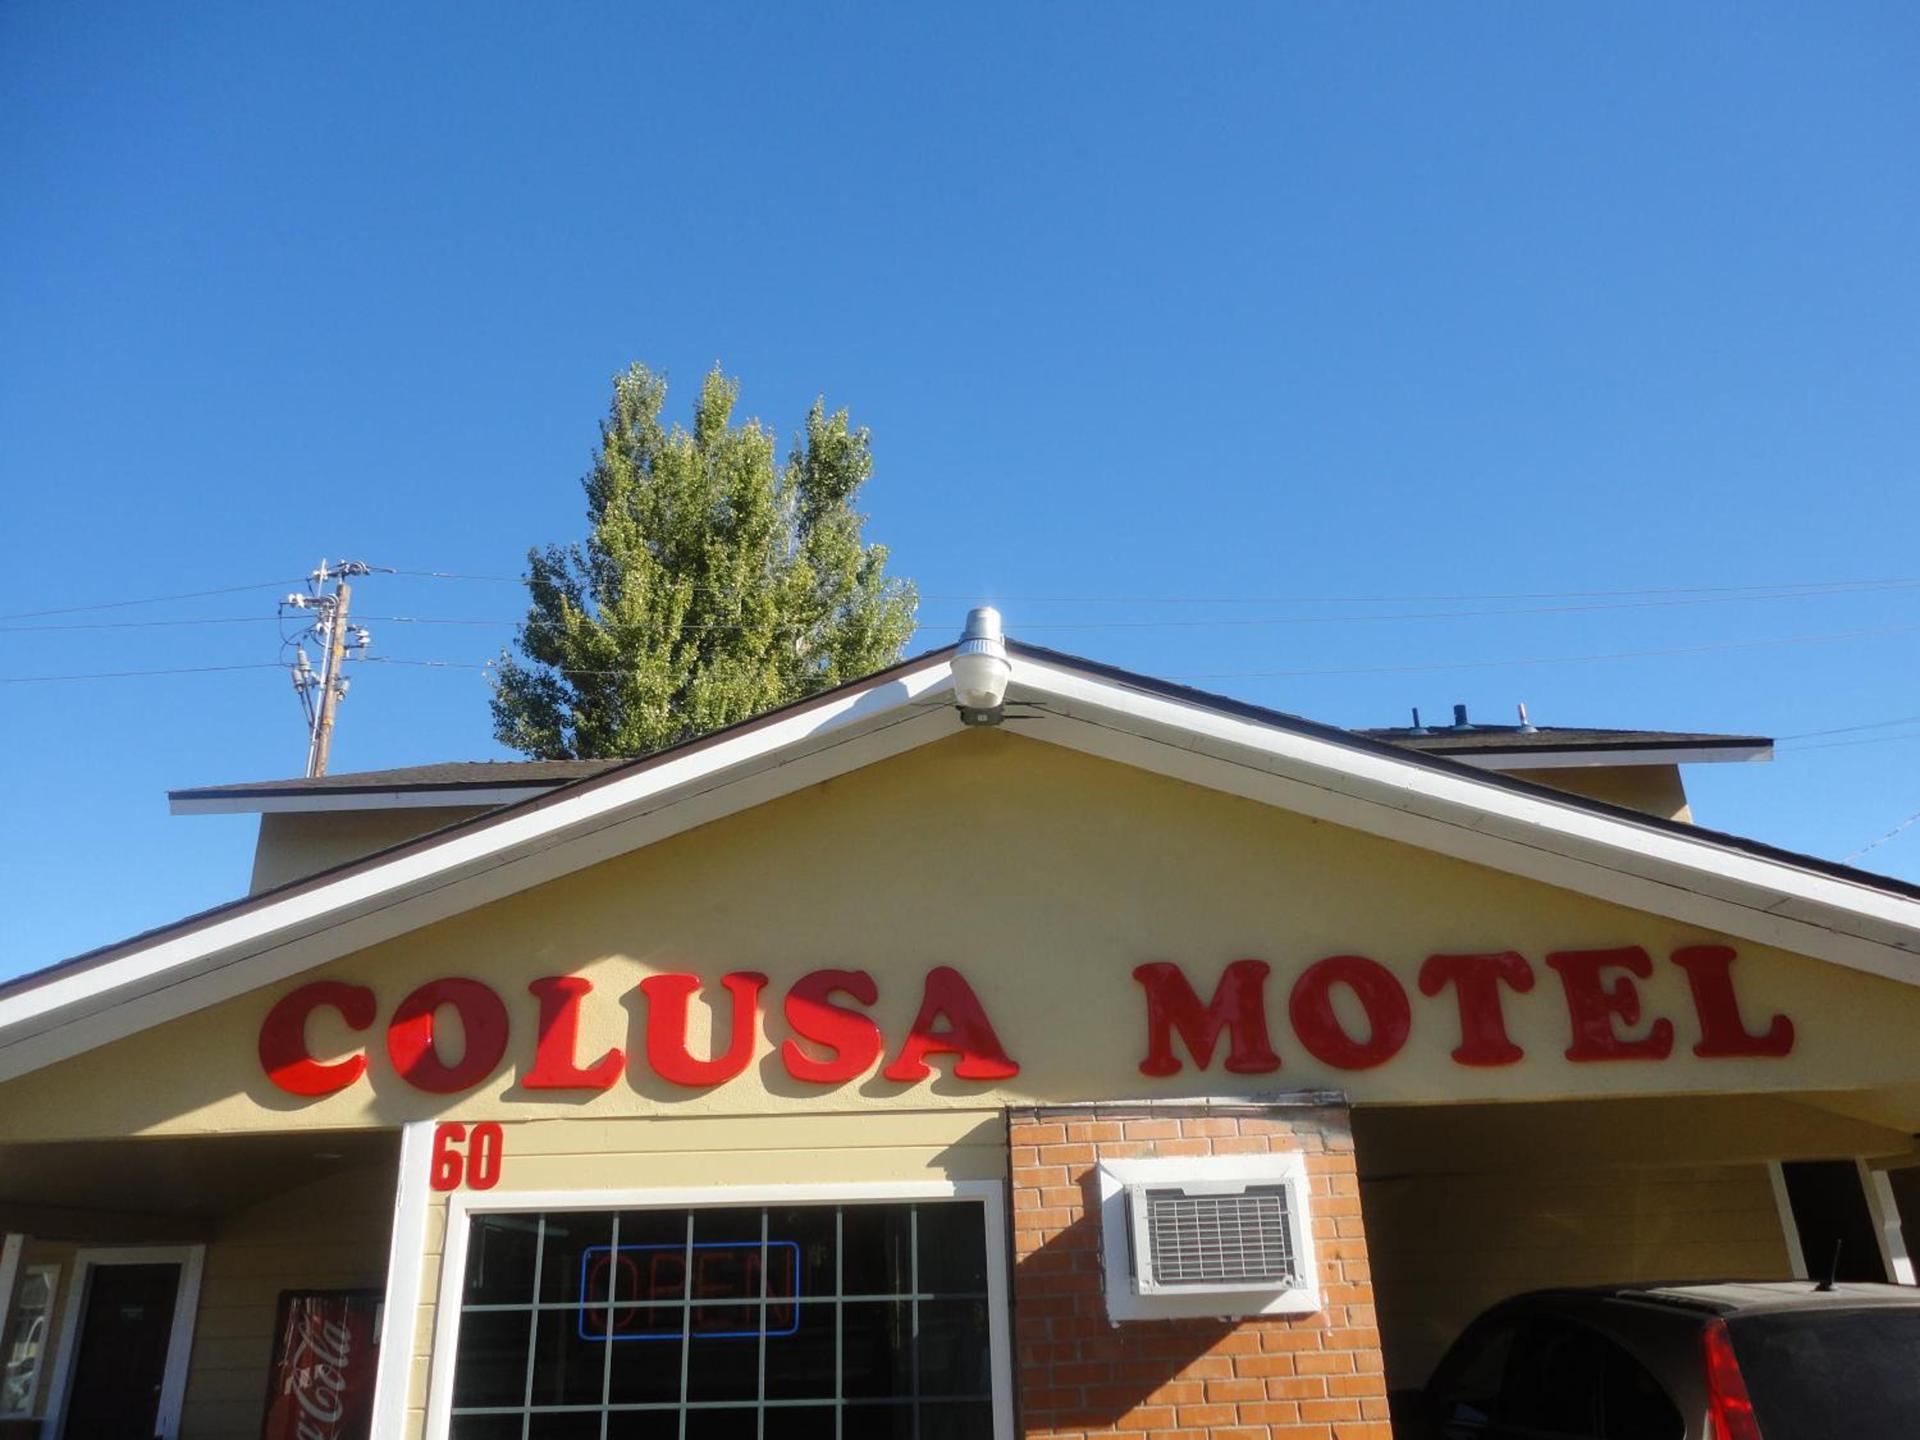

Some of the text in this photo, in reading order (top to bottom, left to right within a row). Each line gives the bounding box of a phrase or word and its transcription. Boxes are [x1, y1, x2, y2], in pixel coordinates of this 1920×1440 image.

[259, 945, 1793, 1097] COLUSA MOTEL
[429, 1121, 503, 1191] 60
[588, 1249, 793, 1330] OPEN
